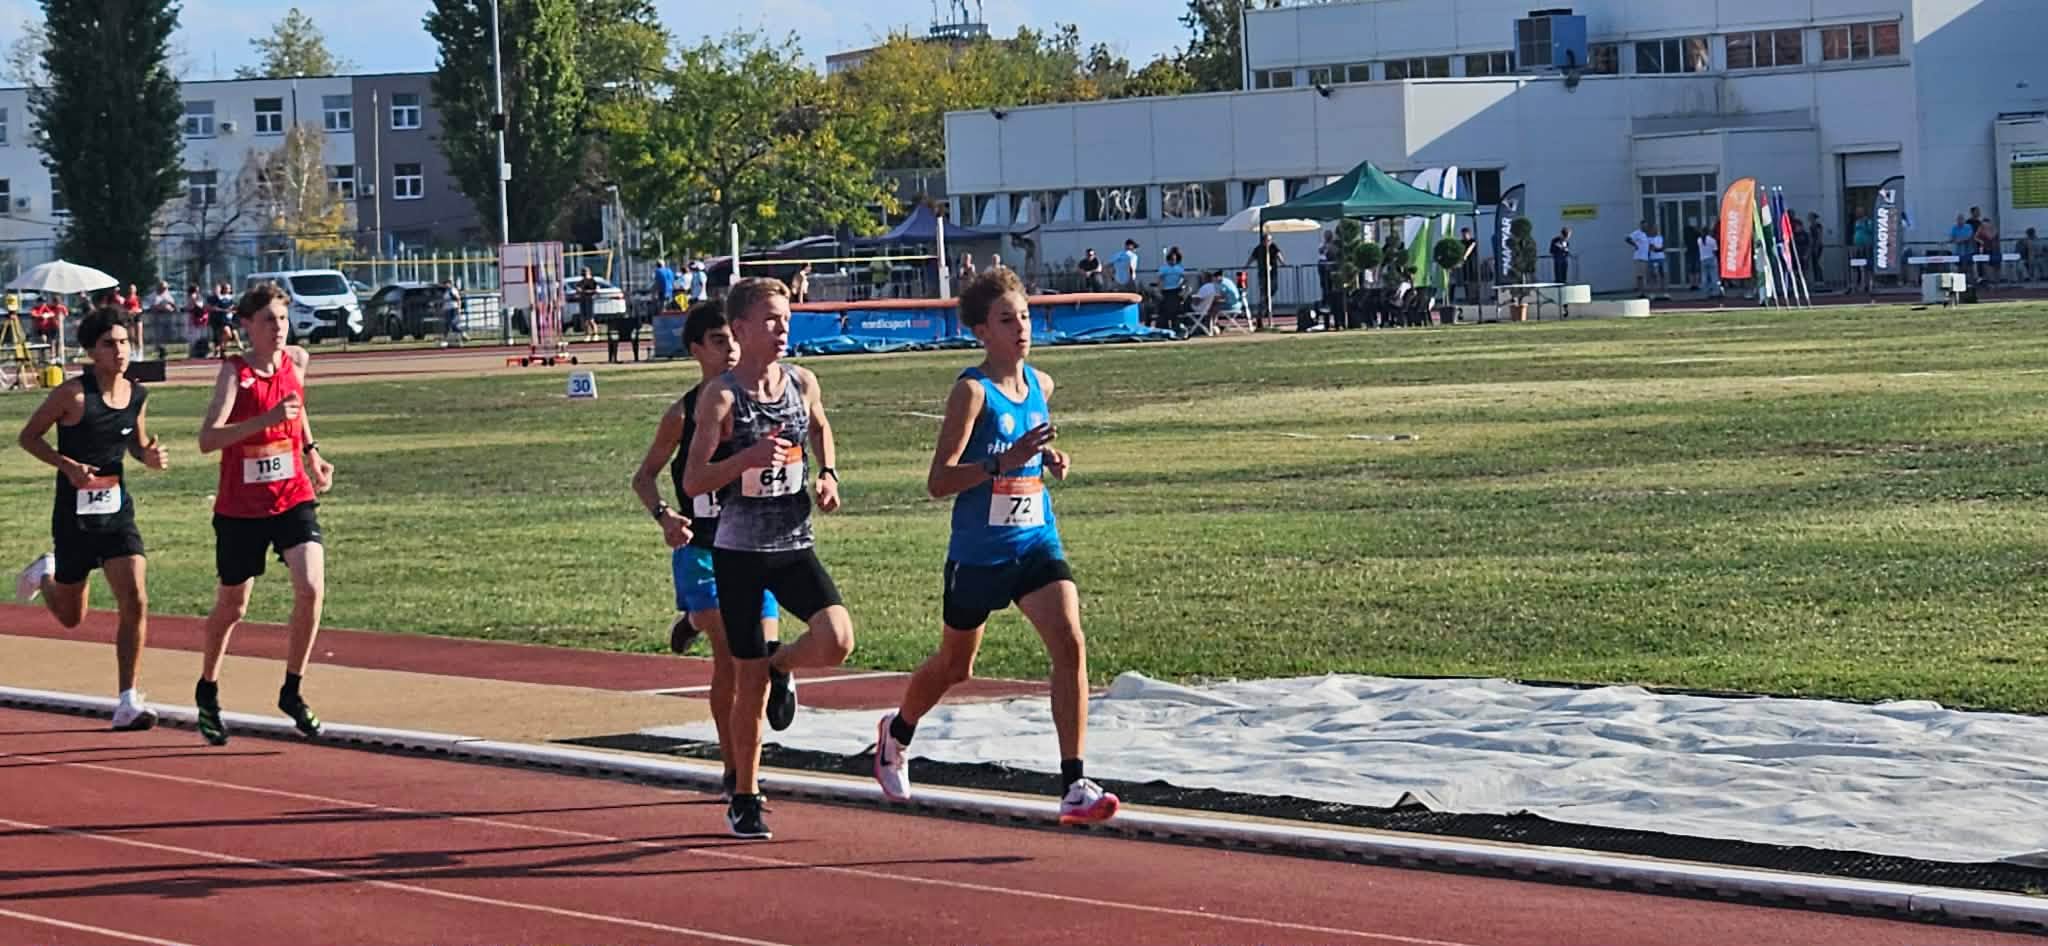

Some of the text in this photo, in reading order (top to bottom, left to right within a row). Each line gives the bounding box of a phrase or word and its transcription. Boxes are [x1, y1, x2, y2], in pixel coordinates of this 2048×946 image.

[572, 378, 591, 393] 30
[256, 456, 281, 474] 118
[760, 466, 788, 486] 64
[1009, 496, 1032, 515] 72
